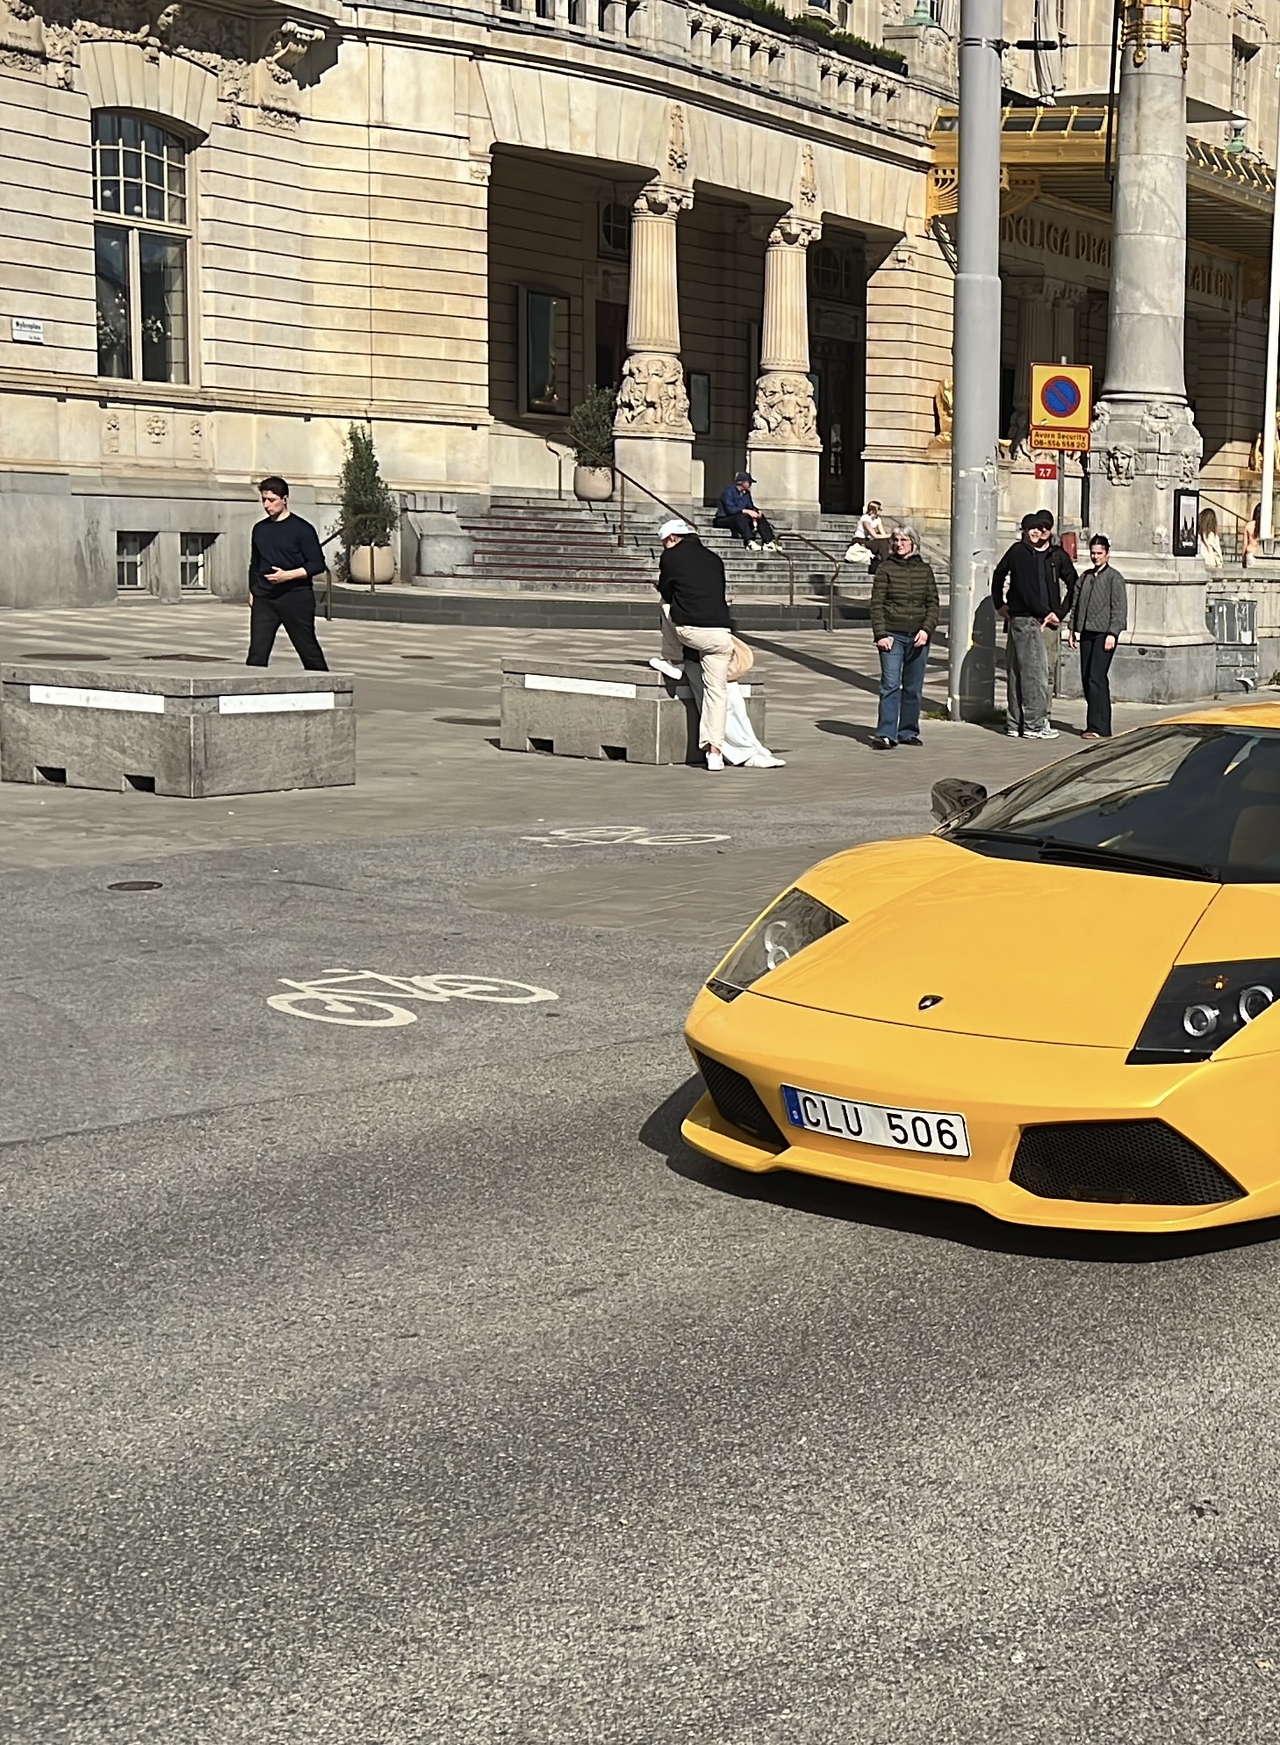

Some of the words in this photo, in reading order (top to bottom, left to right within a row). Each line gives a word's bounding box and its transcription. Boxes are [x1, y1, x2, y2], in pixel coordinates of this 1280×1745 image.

[1057, 433, 1086, 441] Security
[803, 1096, 863, 1137] CLU
[886, 1112, 958, 1150] 506
